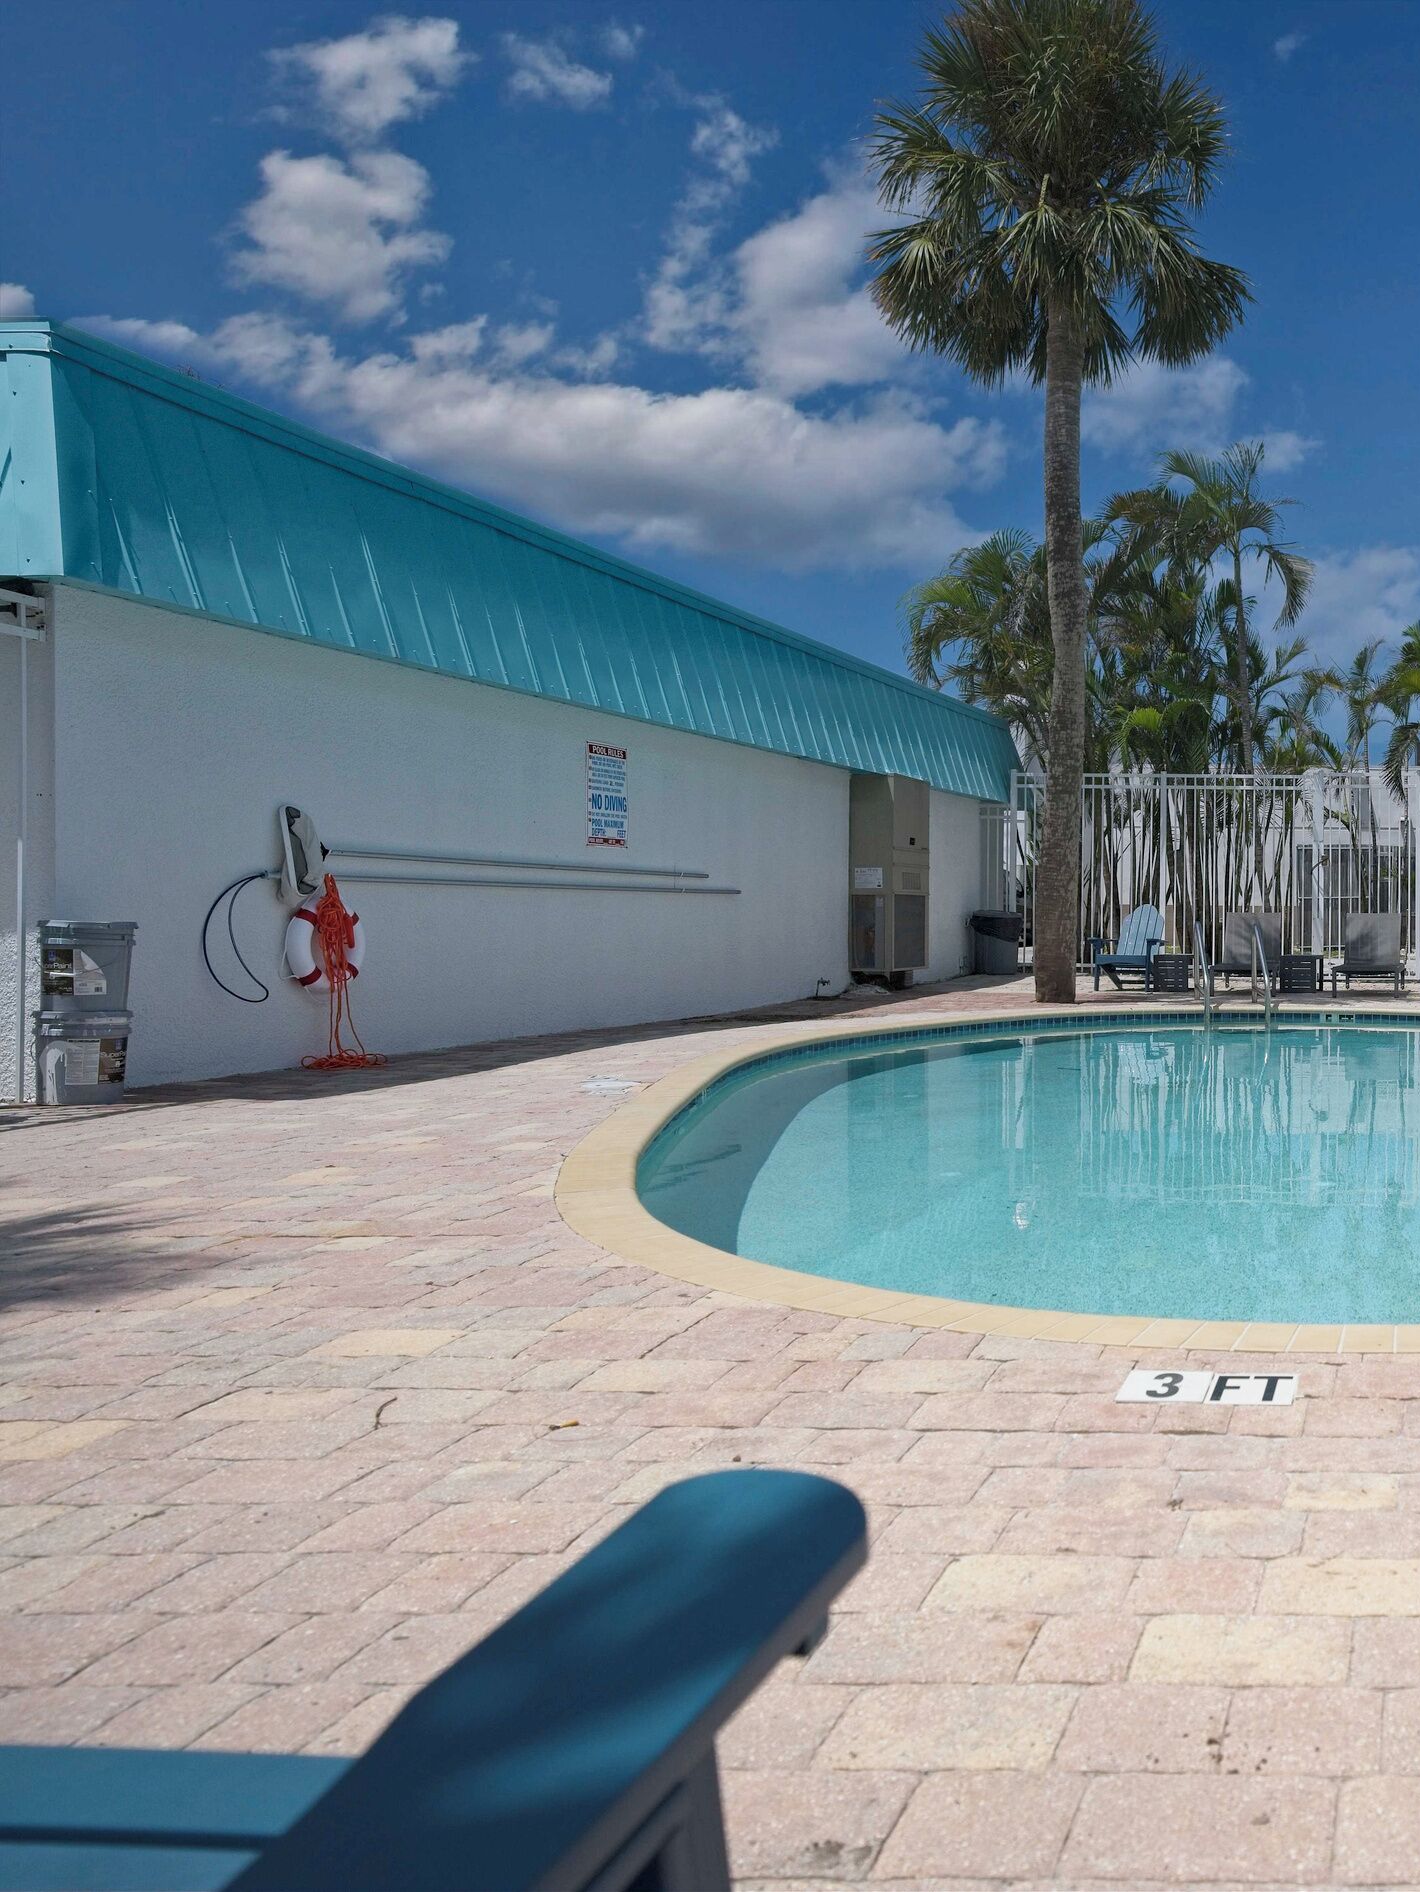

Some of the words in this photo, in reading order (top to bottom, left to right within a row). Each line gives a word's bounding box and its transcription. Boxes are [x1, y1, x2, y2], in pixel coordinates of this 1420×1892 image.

[592, 745, 607, 755] POOL
[608, 748, 623, 758] RULES
[592, 793, 602, 810] NO
[604, 795, 627, 813] DIVING
[592, 818, 603, 828] POOL
[604, 819, 624, 829] MAXIMUM
[617, 829, 626, 838] FEET
[1146, 1373, 1184, 1398] 3
[1210, 1376, 1293, 1401] FT
